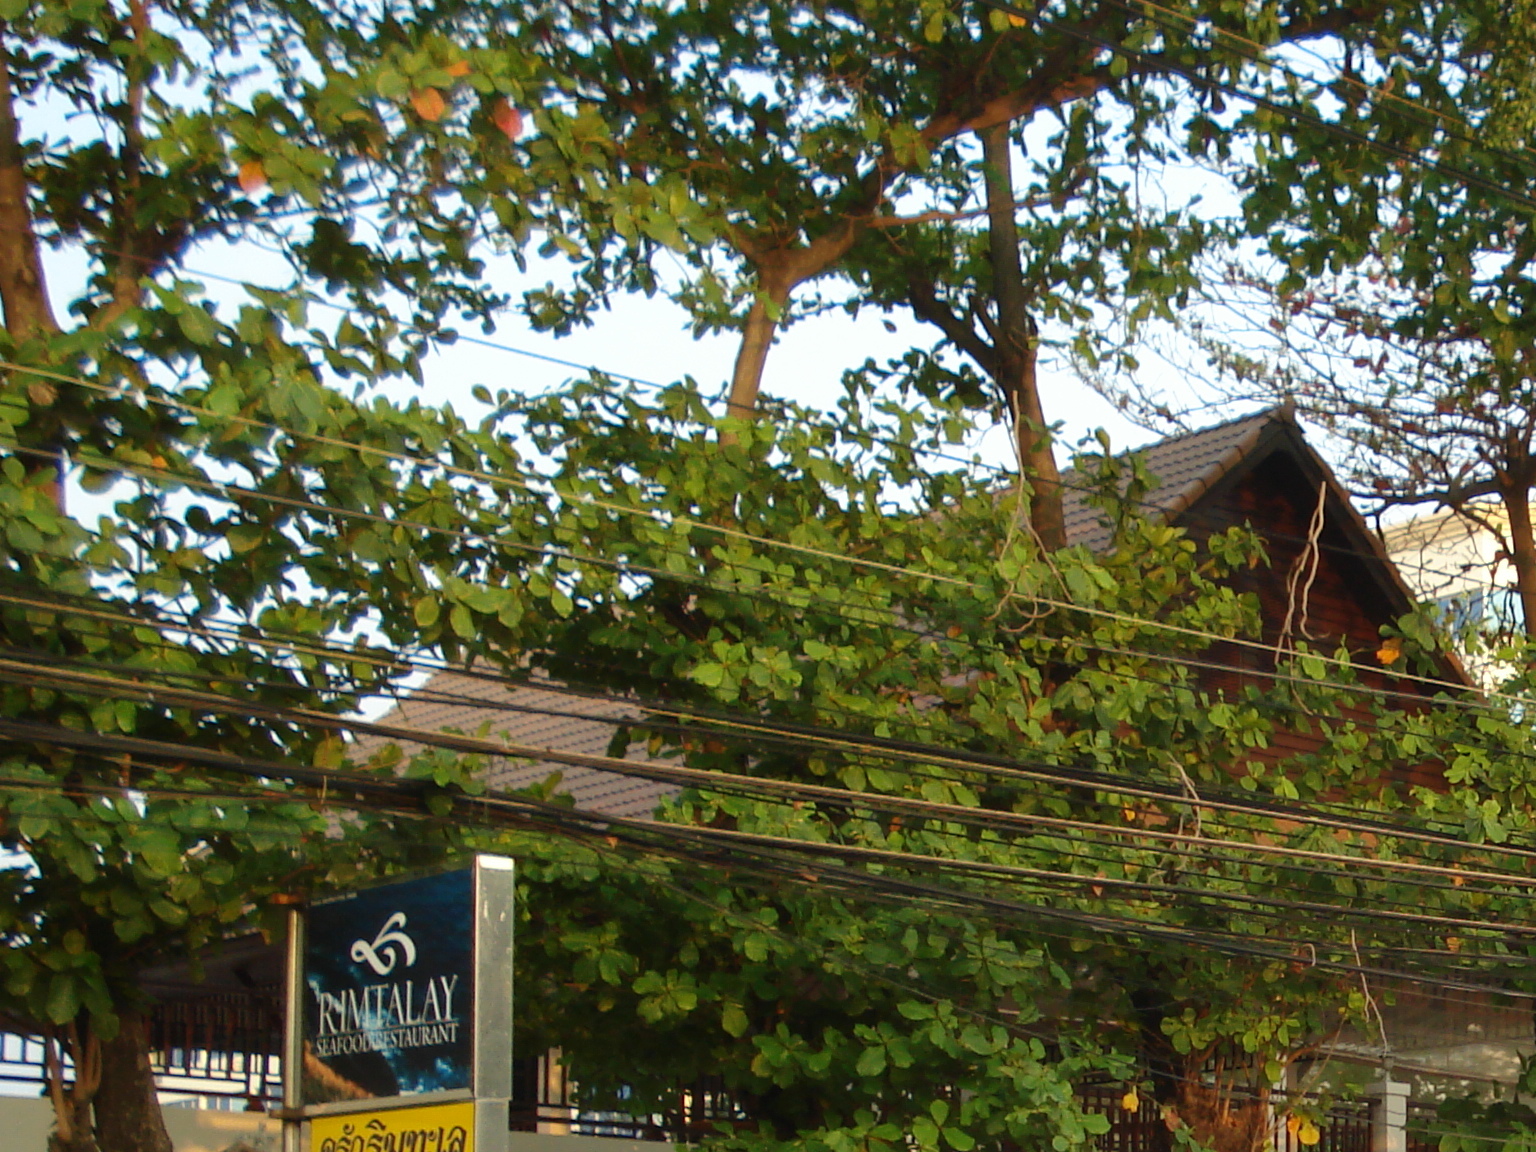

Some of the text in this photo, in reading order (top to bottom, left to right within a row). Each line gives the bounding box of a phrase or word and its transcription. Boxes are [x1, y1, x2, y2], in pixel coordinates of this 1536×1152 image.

[318, 973, 459, 1037] RIMTALAY
[316, 1023, 459, 1058] SEAFOOD RESTAURANT
